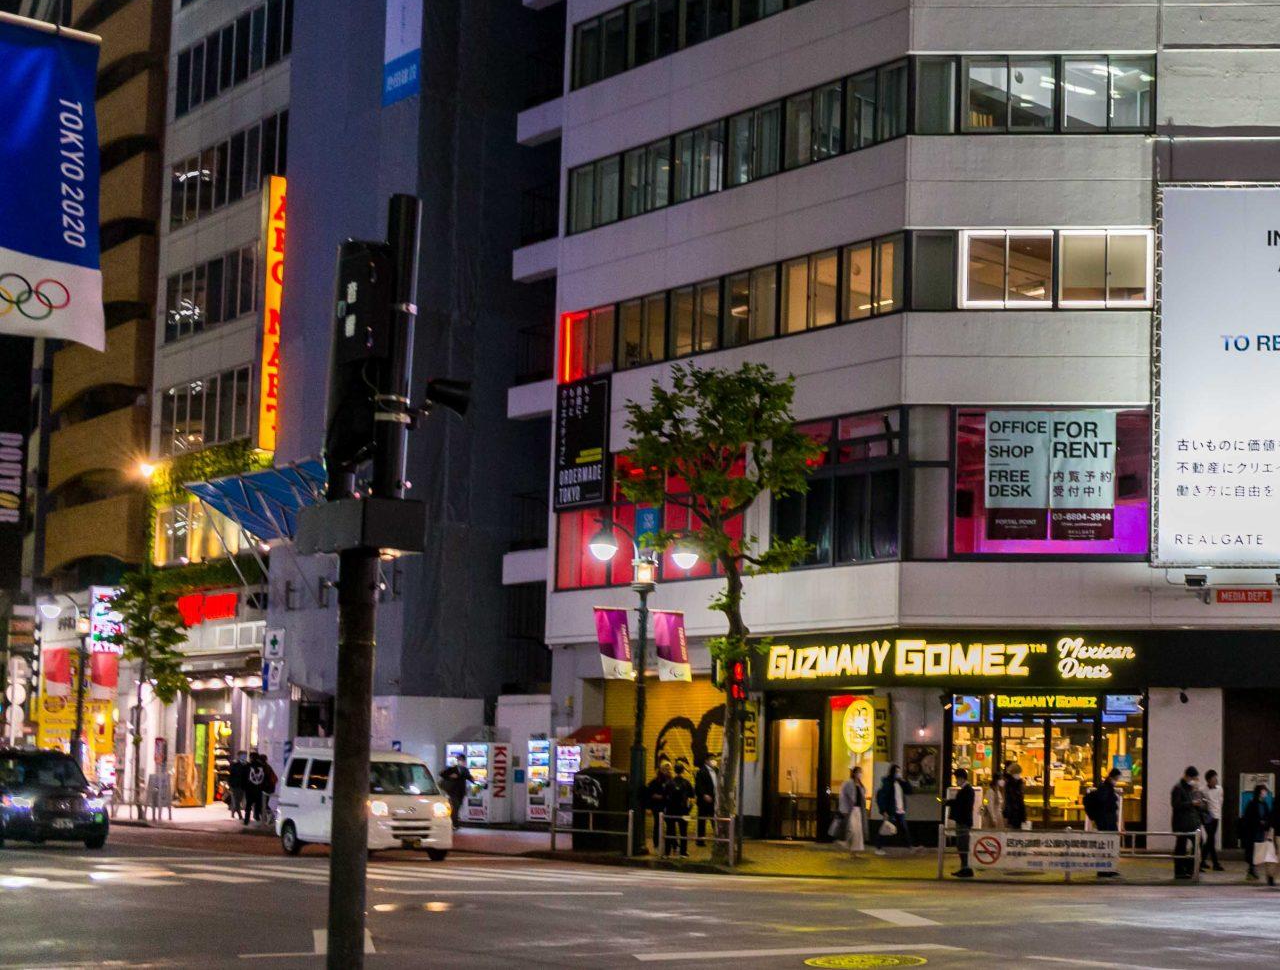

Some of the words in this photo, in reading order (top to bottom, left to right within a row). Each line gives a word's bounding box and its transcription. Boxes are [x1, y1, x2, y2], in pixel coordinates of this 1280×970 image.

[59, 98, 85, 181] TOKYO
[61, 181, 87, 248] 2020
[1220, 334, 1251, 352] TO
[989, 420, 1047, 434] OFFICE
[1053, 421, 1098, 438] FOR
[988, 445, 1034, 458] SHOP
[1053, 441, 1112, 458] RENT
[559, 464, 602, 486] ORDERMADE
[988, 470, 1030, 483] FREE
[1053, 470, 1112, 483] 内覧予約
[559, 486, 581, 503] TOKYO
[988, 484, 1032, 497] DESK
[1176, 484, 1275, 498] 働き方に自由を
[1174, 532, 1265, 547] REALGATE
[1221, 590, 1245, 601] MEDIA
[1056, 637, 1136, 661] Mexican
[894, 639, 1030, 677] GOMEZ
[1057, 658, 1112, 680] Diner
[493, 745, 507, 798] KIRIN
